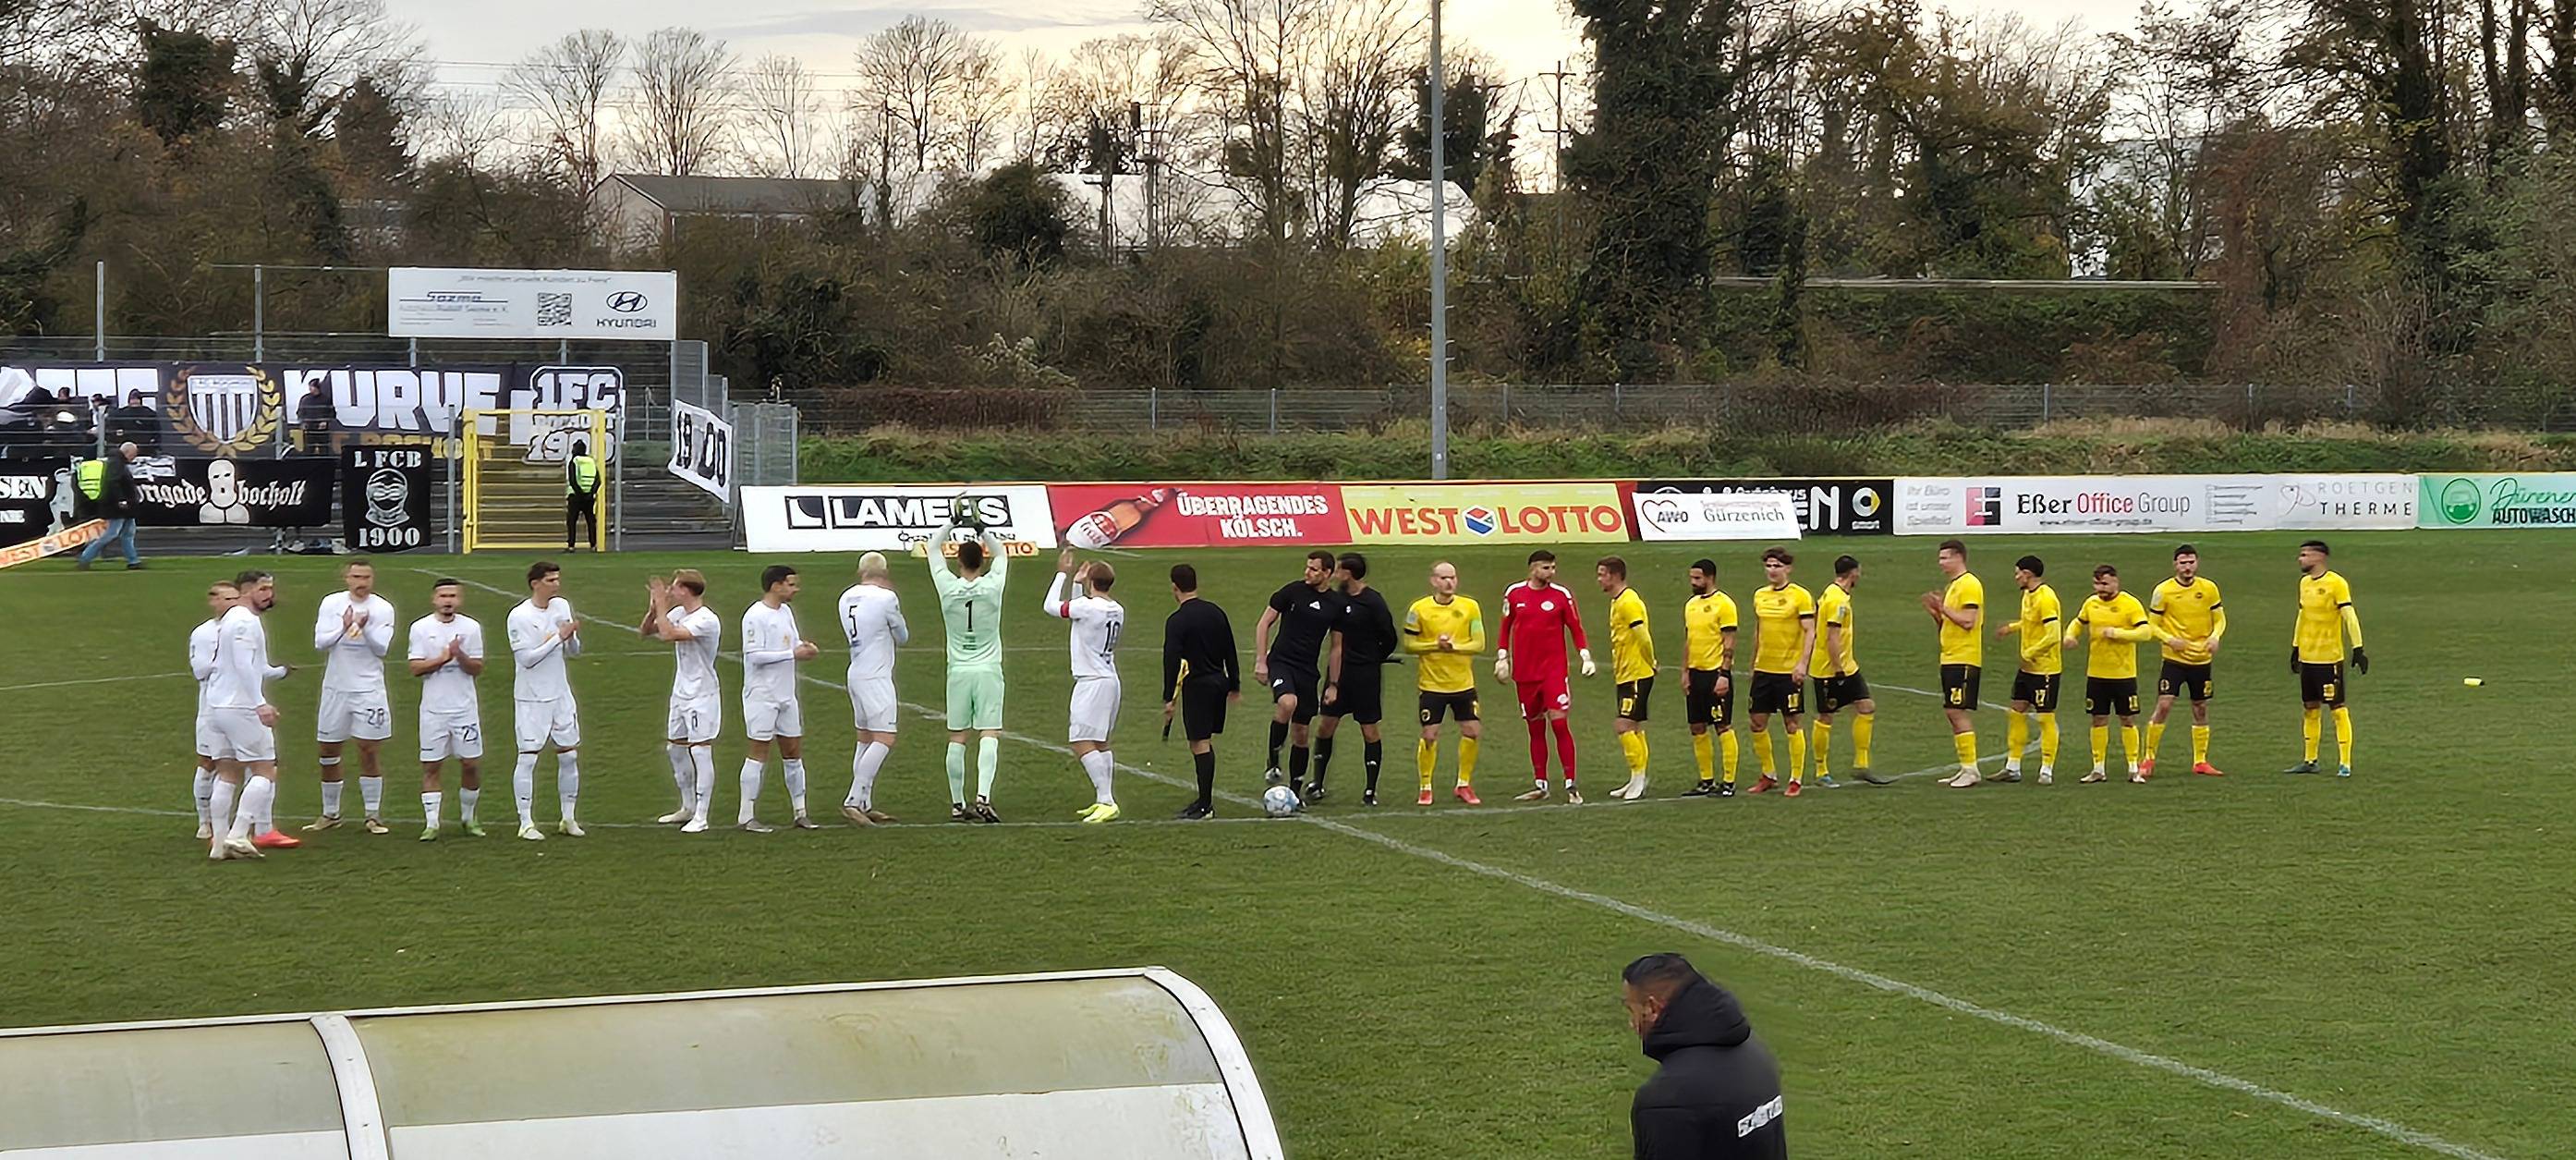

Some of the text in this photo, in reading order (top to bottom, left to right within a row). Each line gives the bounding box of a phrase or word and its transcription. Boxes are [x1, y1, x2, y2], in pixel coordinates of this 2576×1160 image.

[596, 318, 657, 327] HYUNDAI
[375, 450, 421, 468] FCB
[2317, 482, 2412, 495] ROETGEN
[1176, 492, 1329, 516] ÜBERRAGENDES
[2017, 495, 2072, 514] Eßer
[2078, 492, 2133, 514] Office
[2138, 492, 2191, 517] Group
[2320, 501, 2412, 516] THERME
[1350, 505, 1622, 534] WEST LOTTO
[1703, 507, 1785, 522] Gürzenich
[1220, 513, 1304, 538] KÖLSCH.
[358, 527, 420, 547] 1900
[965, 600, 973, 632] 1
